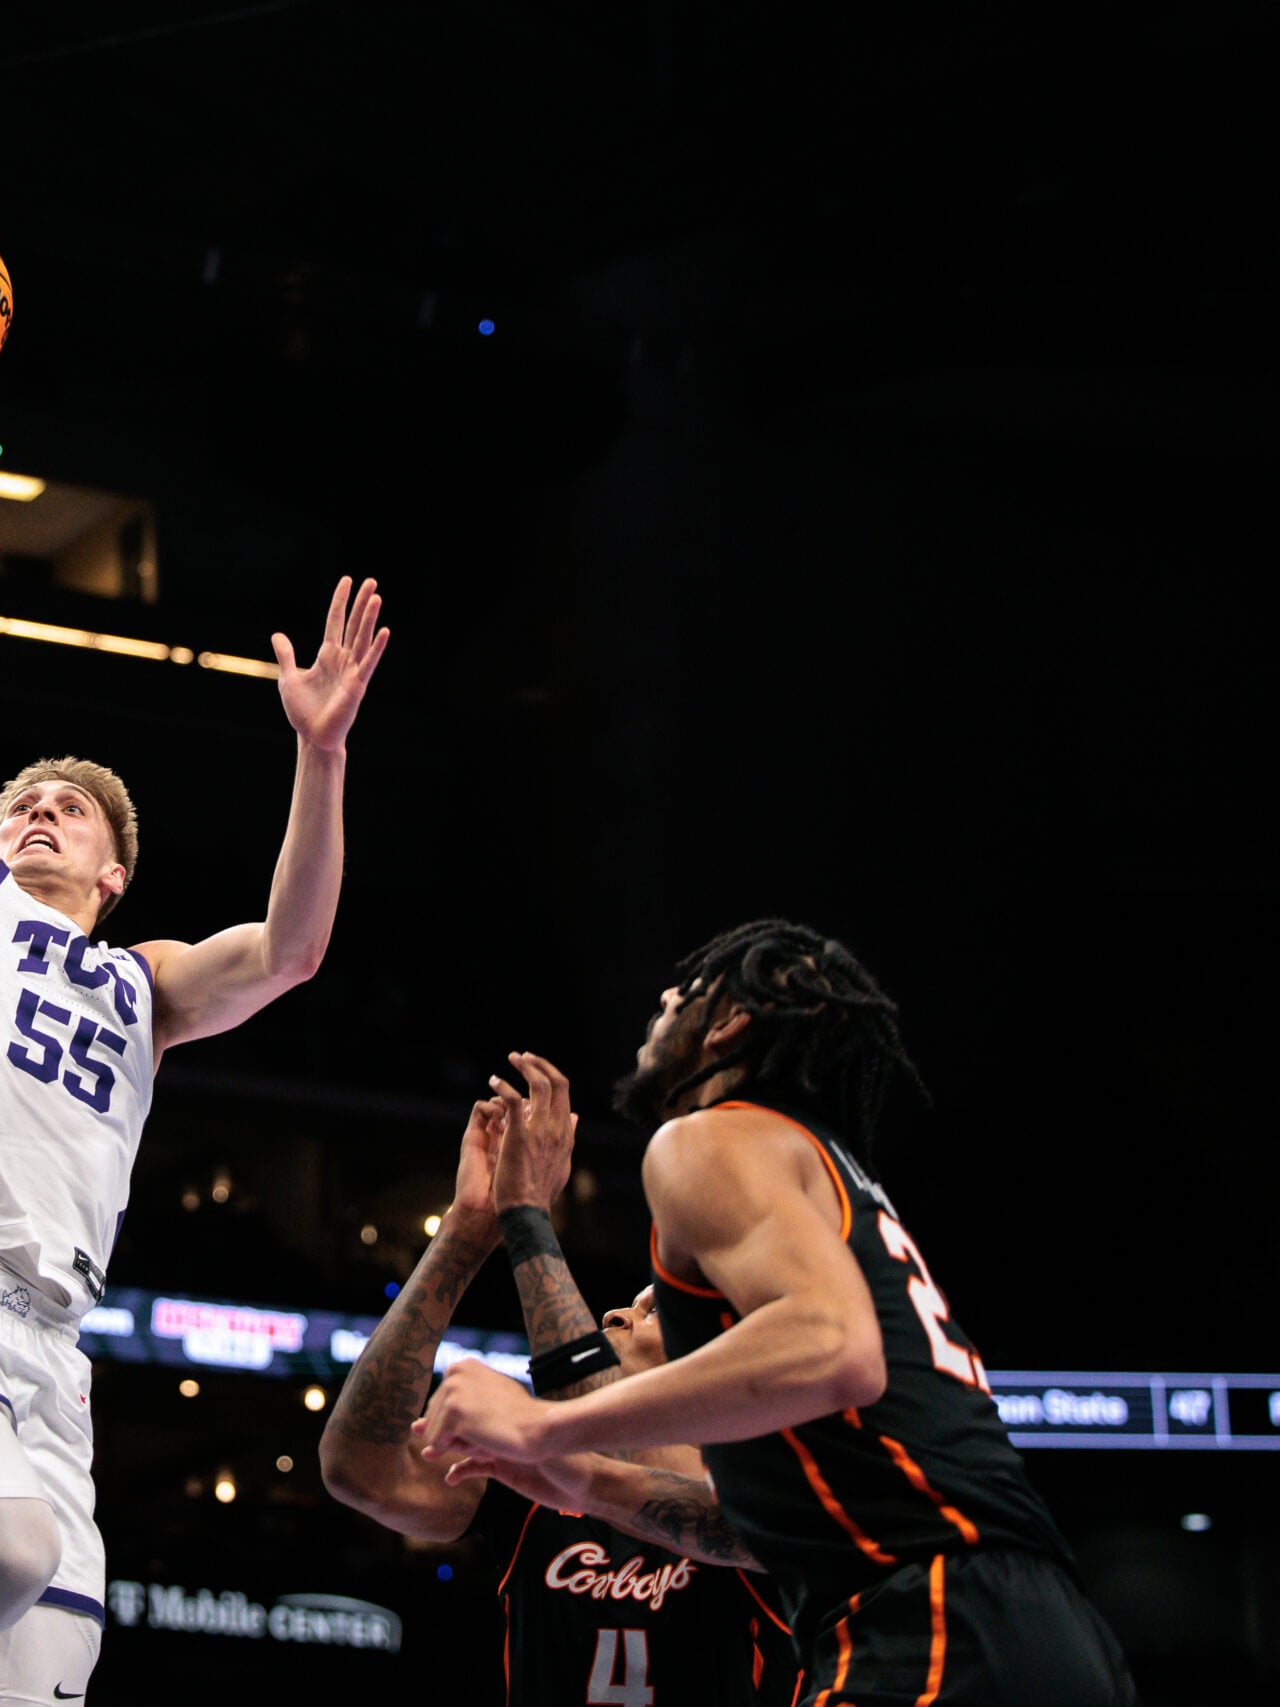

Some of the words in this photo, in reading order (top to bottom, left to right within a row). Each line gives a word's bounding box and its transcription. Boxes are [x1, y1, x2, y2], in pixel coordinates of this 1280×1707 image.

[6, 987, 128, 1114] 55
[545, 1541, 698, 1612] Cowboys
[148, 1583, 268, 1639] Mobile
[269, 1602, 394, 1650] CENTER
[586, 1627, 655, 1707] 4
